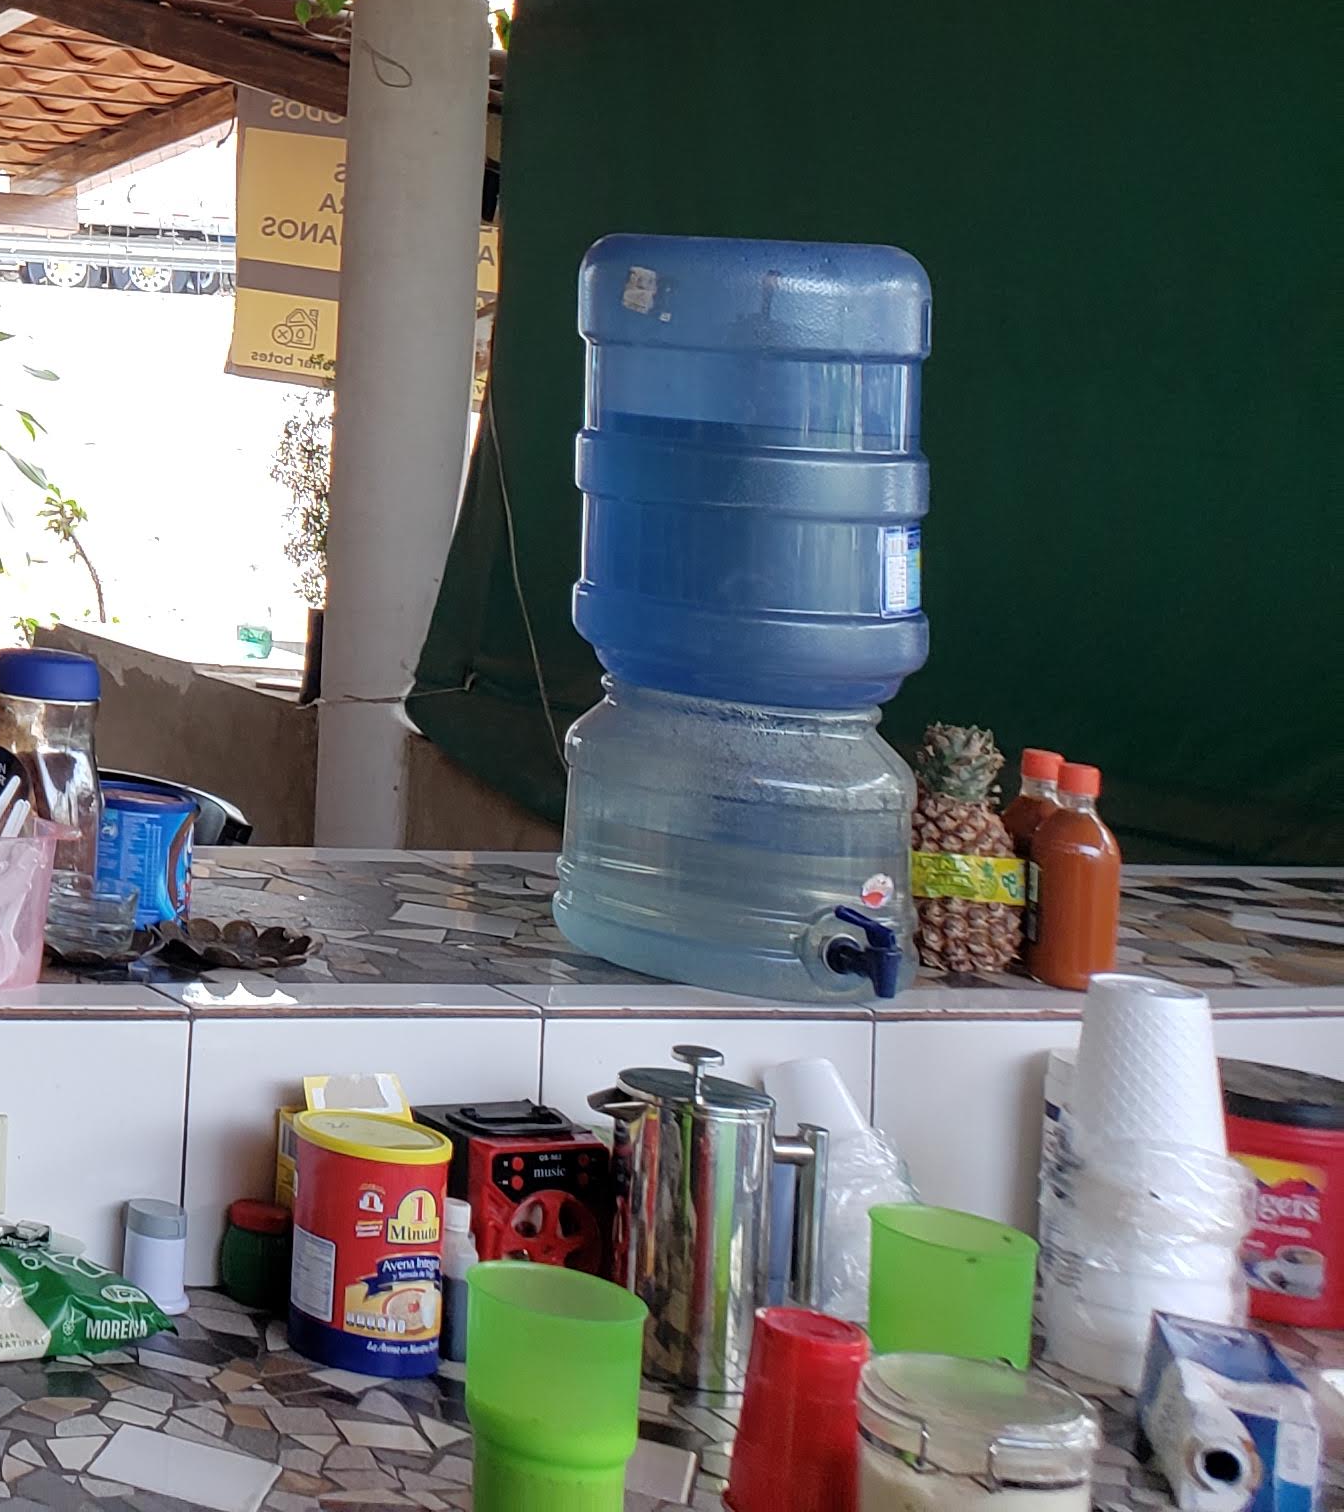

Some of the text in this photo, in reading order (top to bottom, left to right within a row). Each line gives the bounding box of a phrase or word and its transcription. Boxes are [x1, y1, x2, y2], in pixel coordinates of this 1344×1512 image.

[533, 1164, 566, 1178] music
[413, 1196, 428, 1224] 1
[390, 1224, 437, 1240] Minuto
[382, 1260, 414, 1272] Avena
[86, 1318, 148, 1340] MORENA
